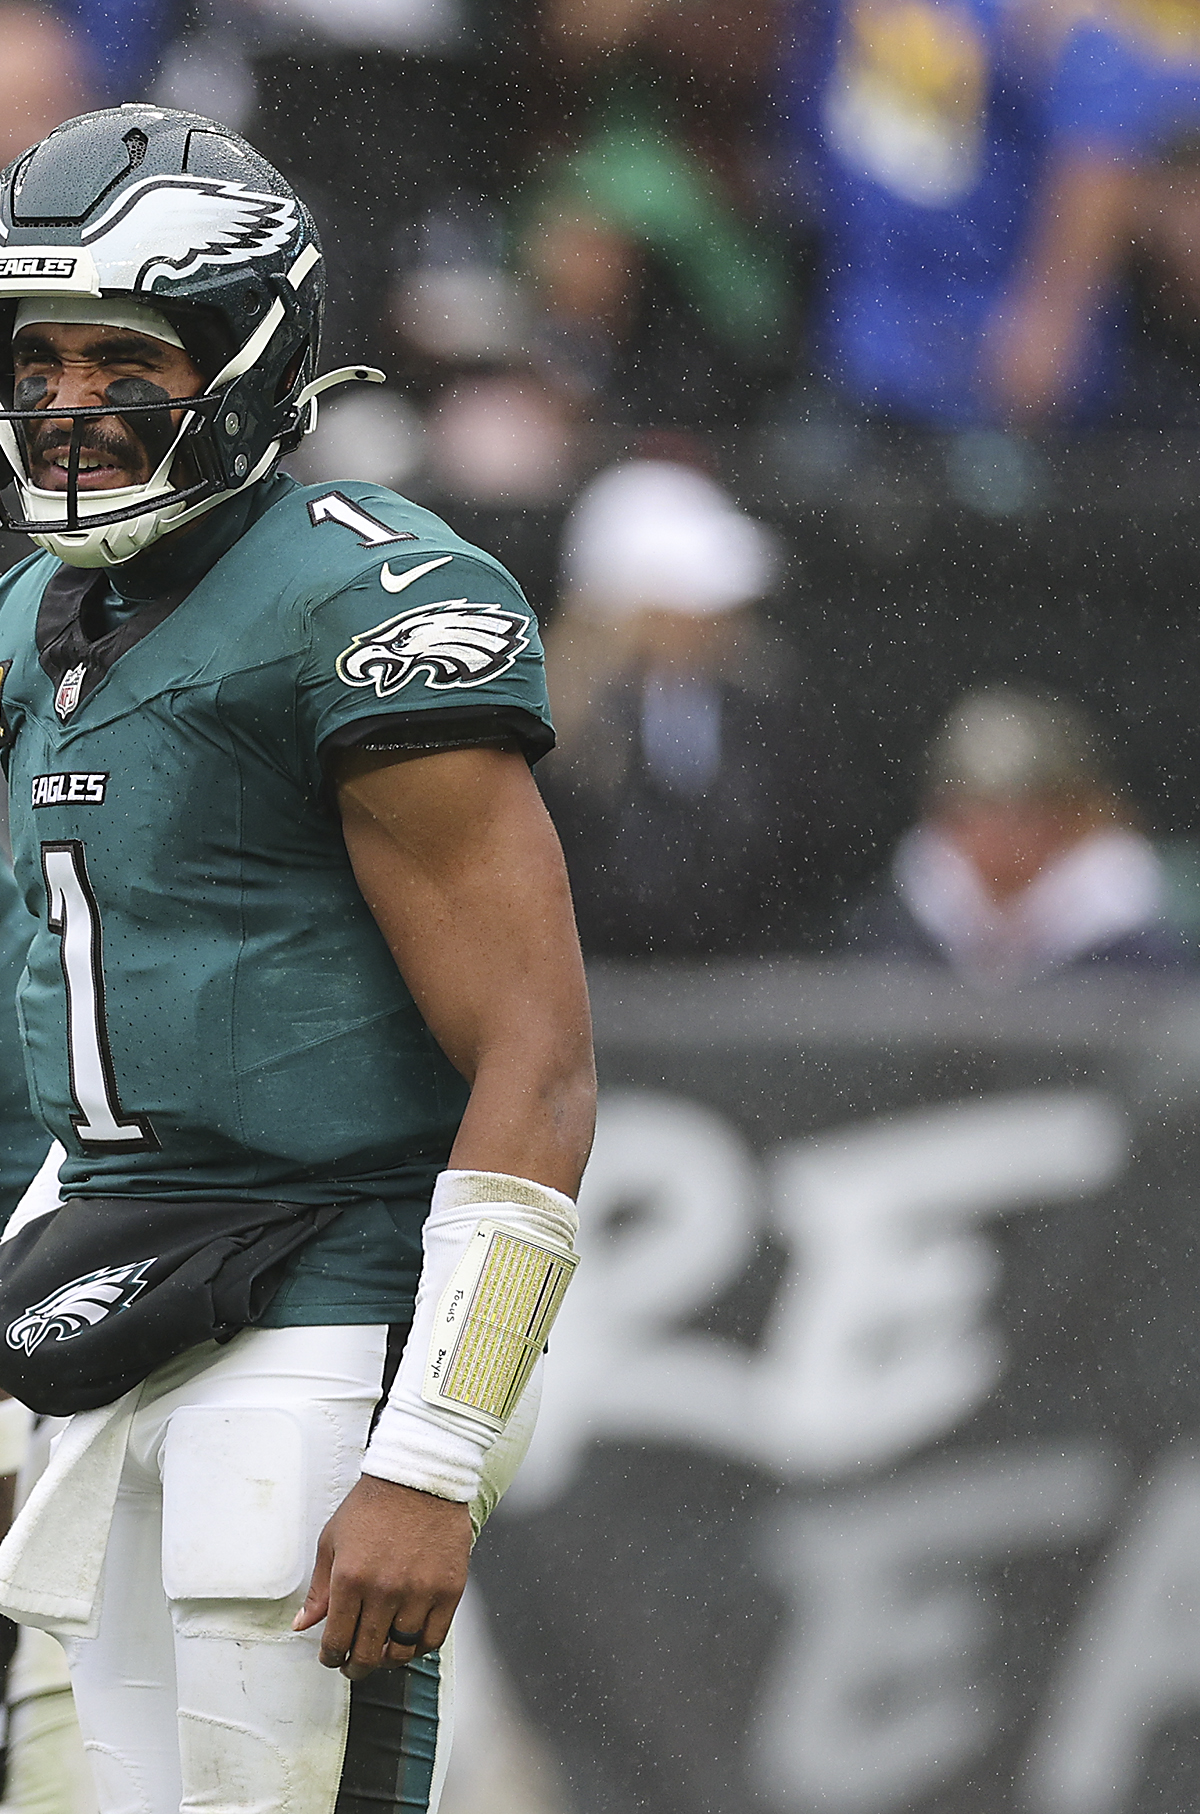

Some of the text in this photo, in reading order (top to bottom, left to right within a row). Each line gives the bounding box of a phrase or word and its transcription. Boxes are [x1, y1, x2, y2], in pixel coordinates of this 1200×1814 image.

[307, 490, 419, 549] 1
[31, 773, 108, 808] EAGLES
[41, 840, 161, 1152] 1
